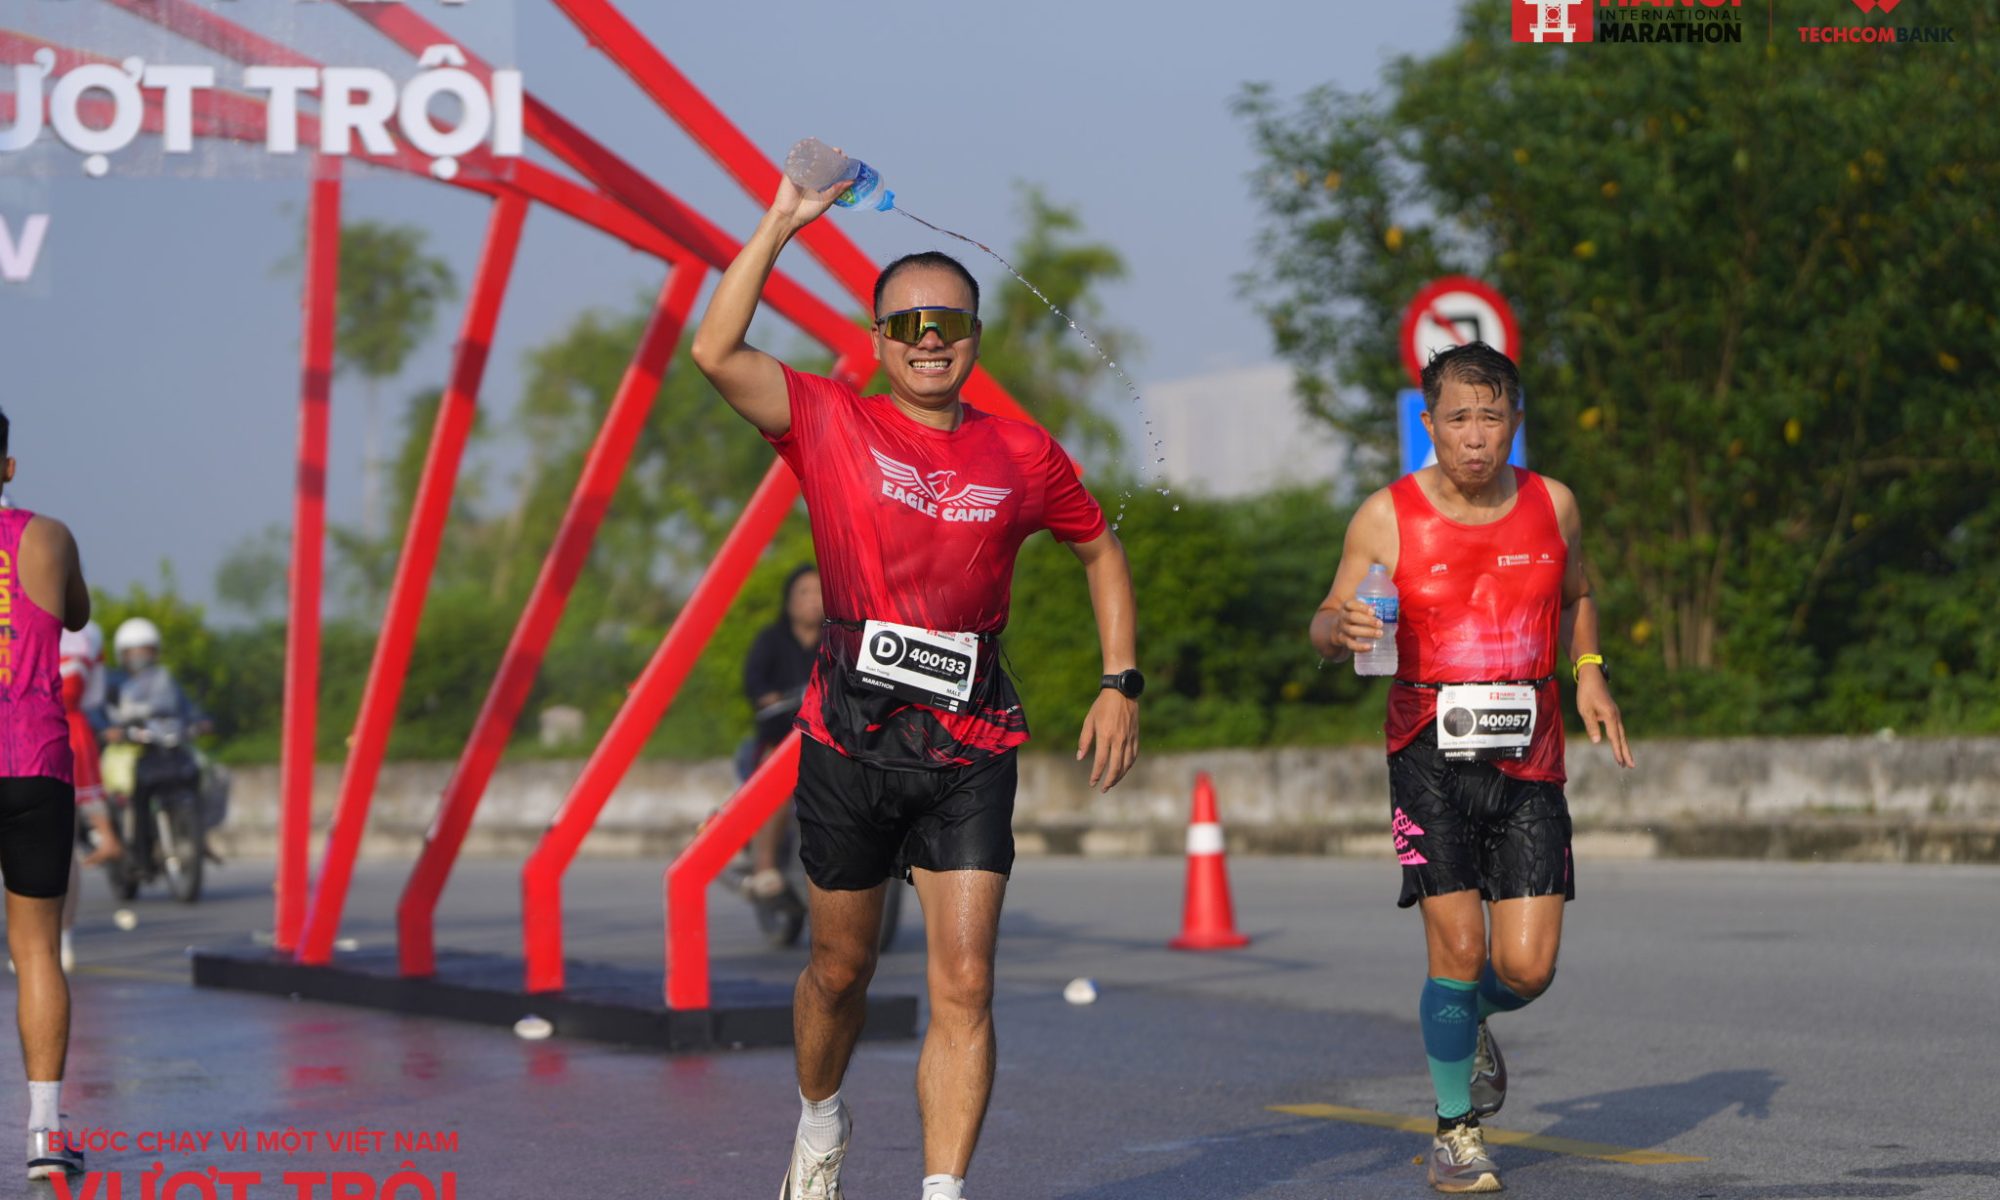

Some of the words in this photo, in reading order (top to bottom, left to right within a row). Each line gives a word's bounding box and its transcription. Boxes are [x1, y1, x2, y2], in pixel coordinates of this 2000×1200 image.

[245, 44, 523, 180] TRỘI
[882, 480, 938, 518] EAGLE
[942, 508, 997, 522] CAMP
[876, 636, 897, 658] D
[908, 648, 966, 675] 400133
[862, 677, 895, 690] MARATHON
[1479, 714, 1529, 727] 400957
